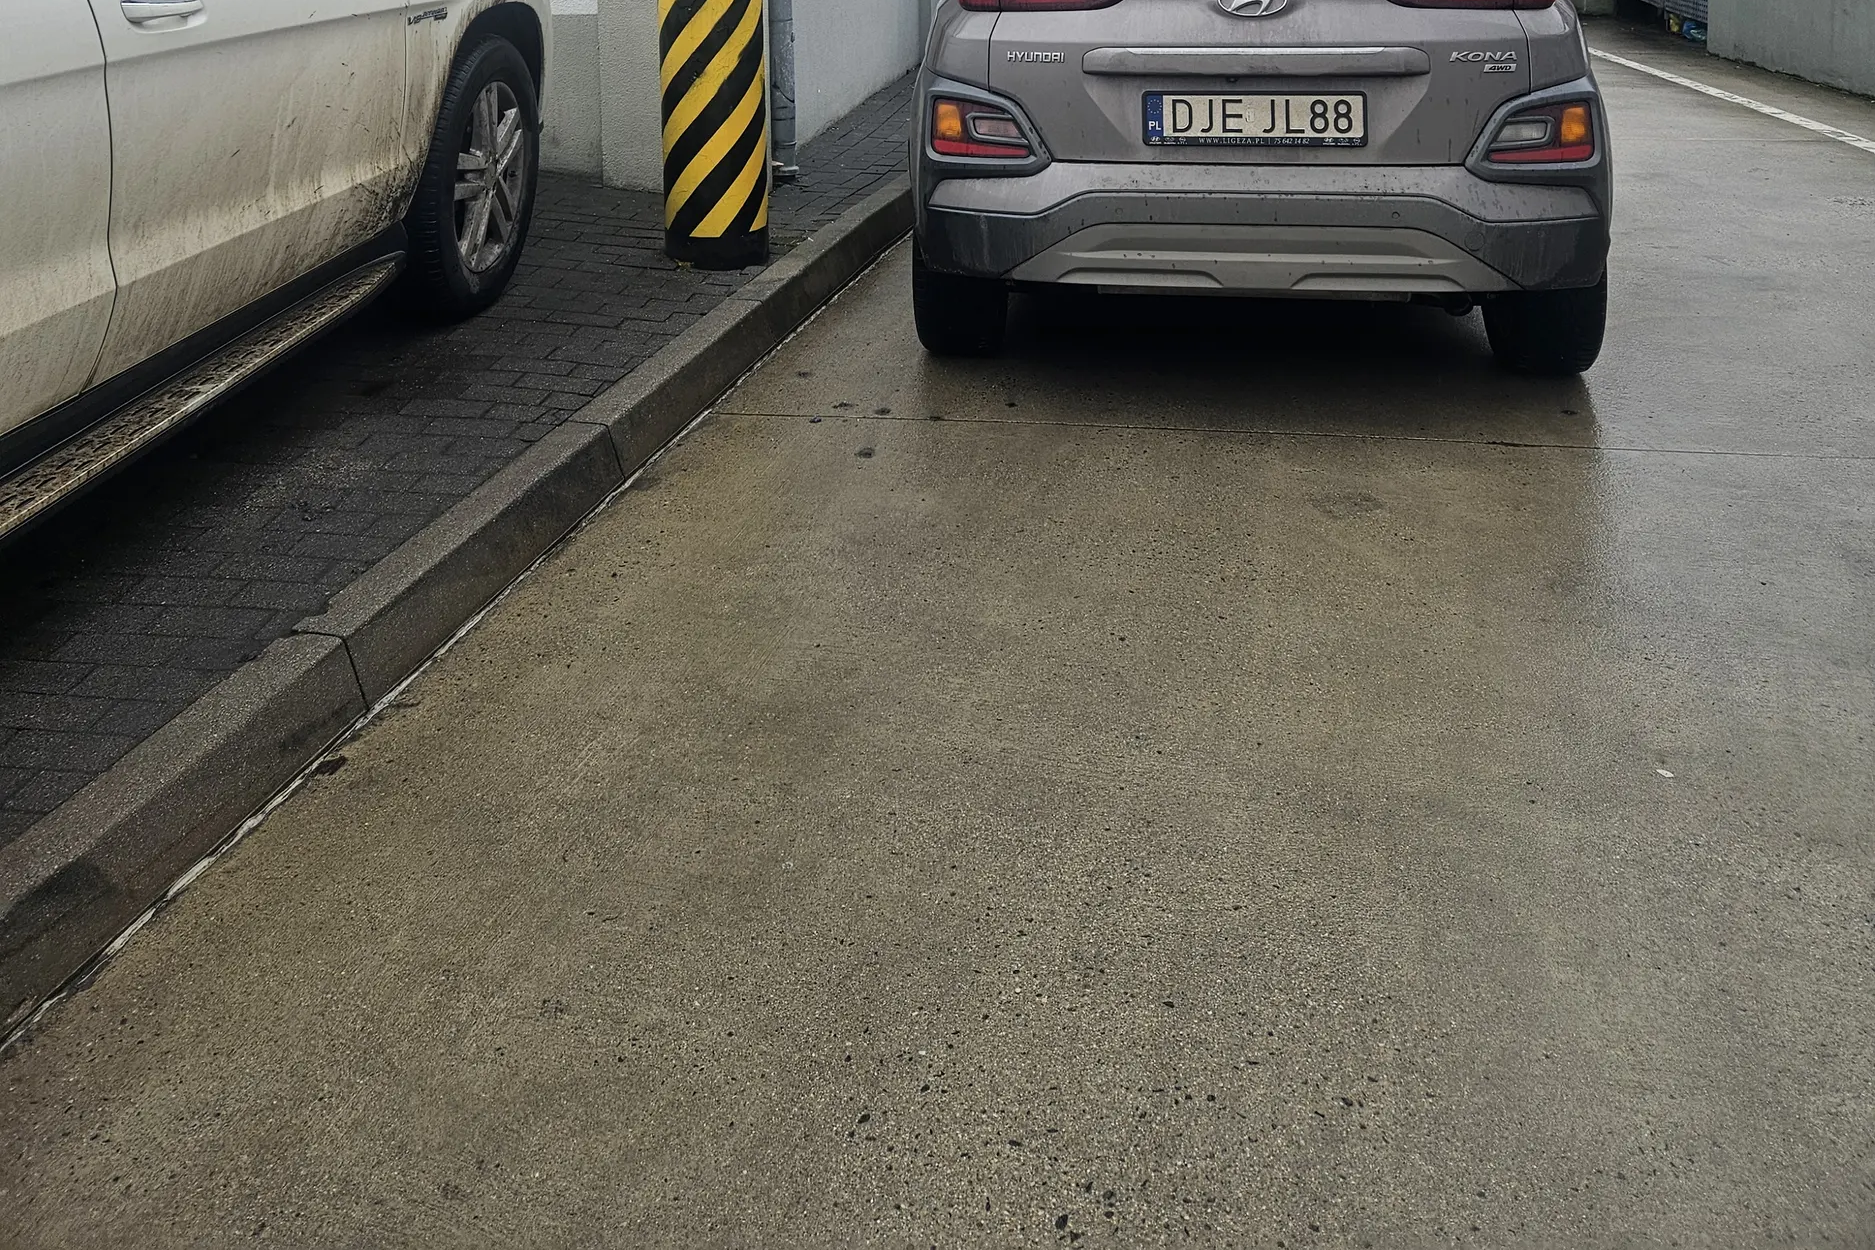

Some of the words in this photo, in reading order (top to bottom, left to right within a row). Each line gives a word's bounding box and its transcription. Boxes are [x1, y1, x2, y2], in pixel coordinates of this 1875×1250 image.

[1007, 51, 1065, 62] HYUNDAI
[1449, 51, 1517, 62] KONA
[1171, 98, 1243, 134] DJE
[1262, 98, 1353, 134] JL88
[1148, 120, 1162, 131] PL
